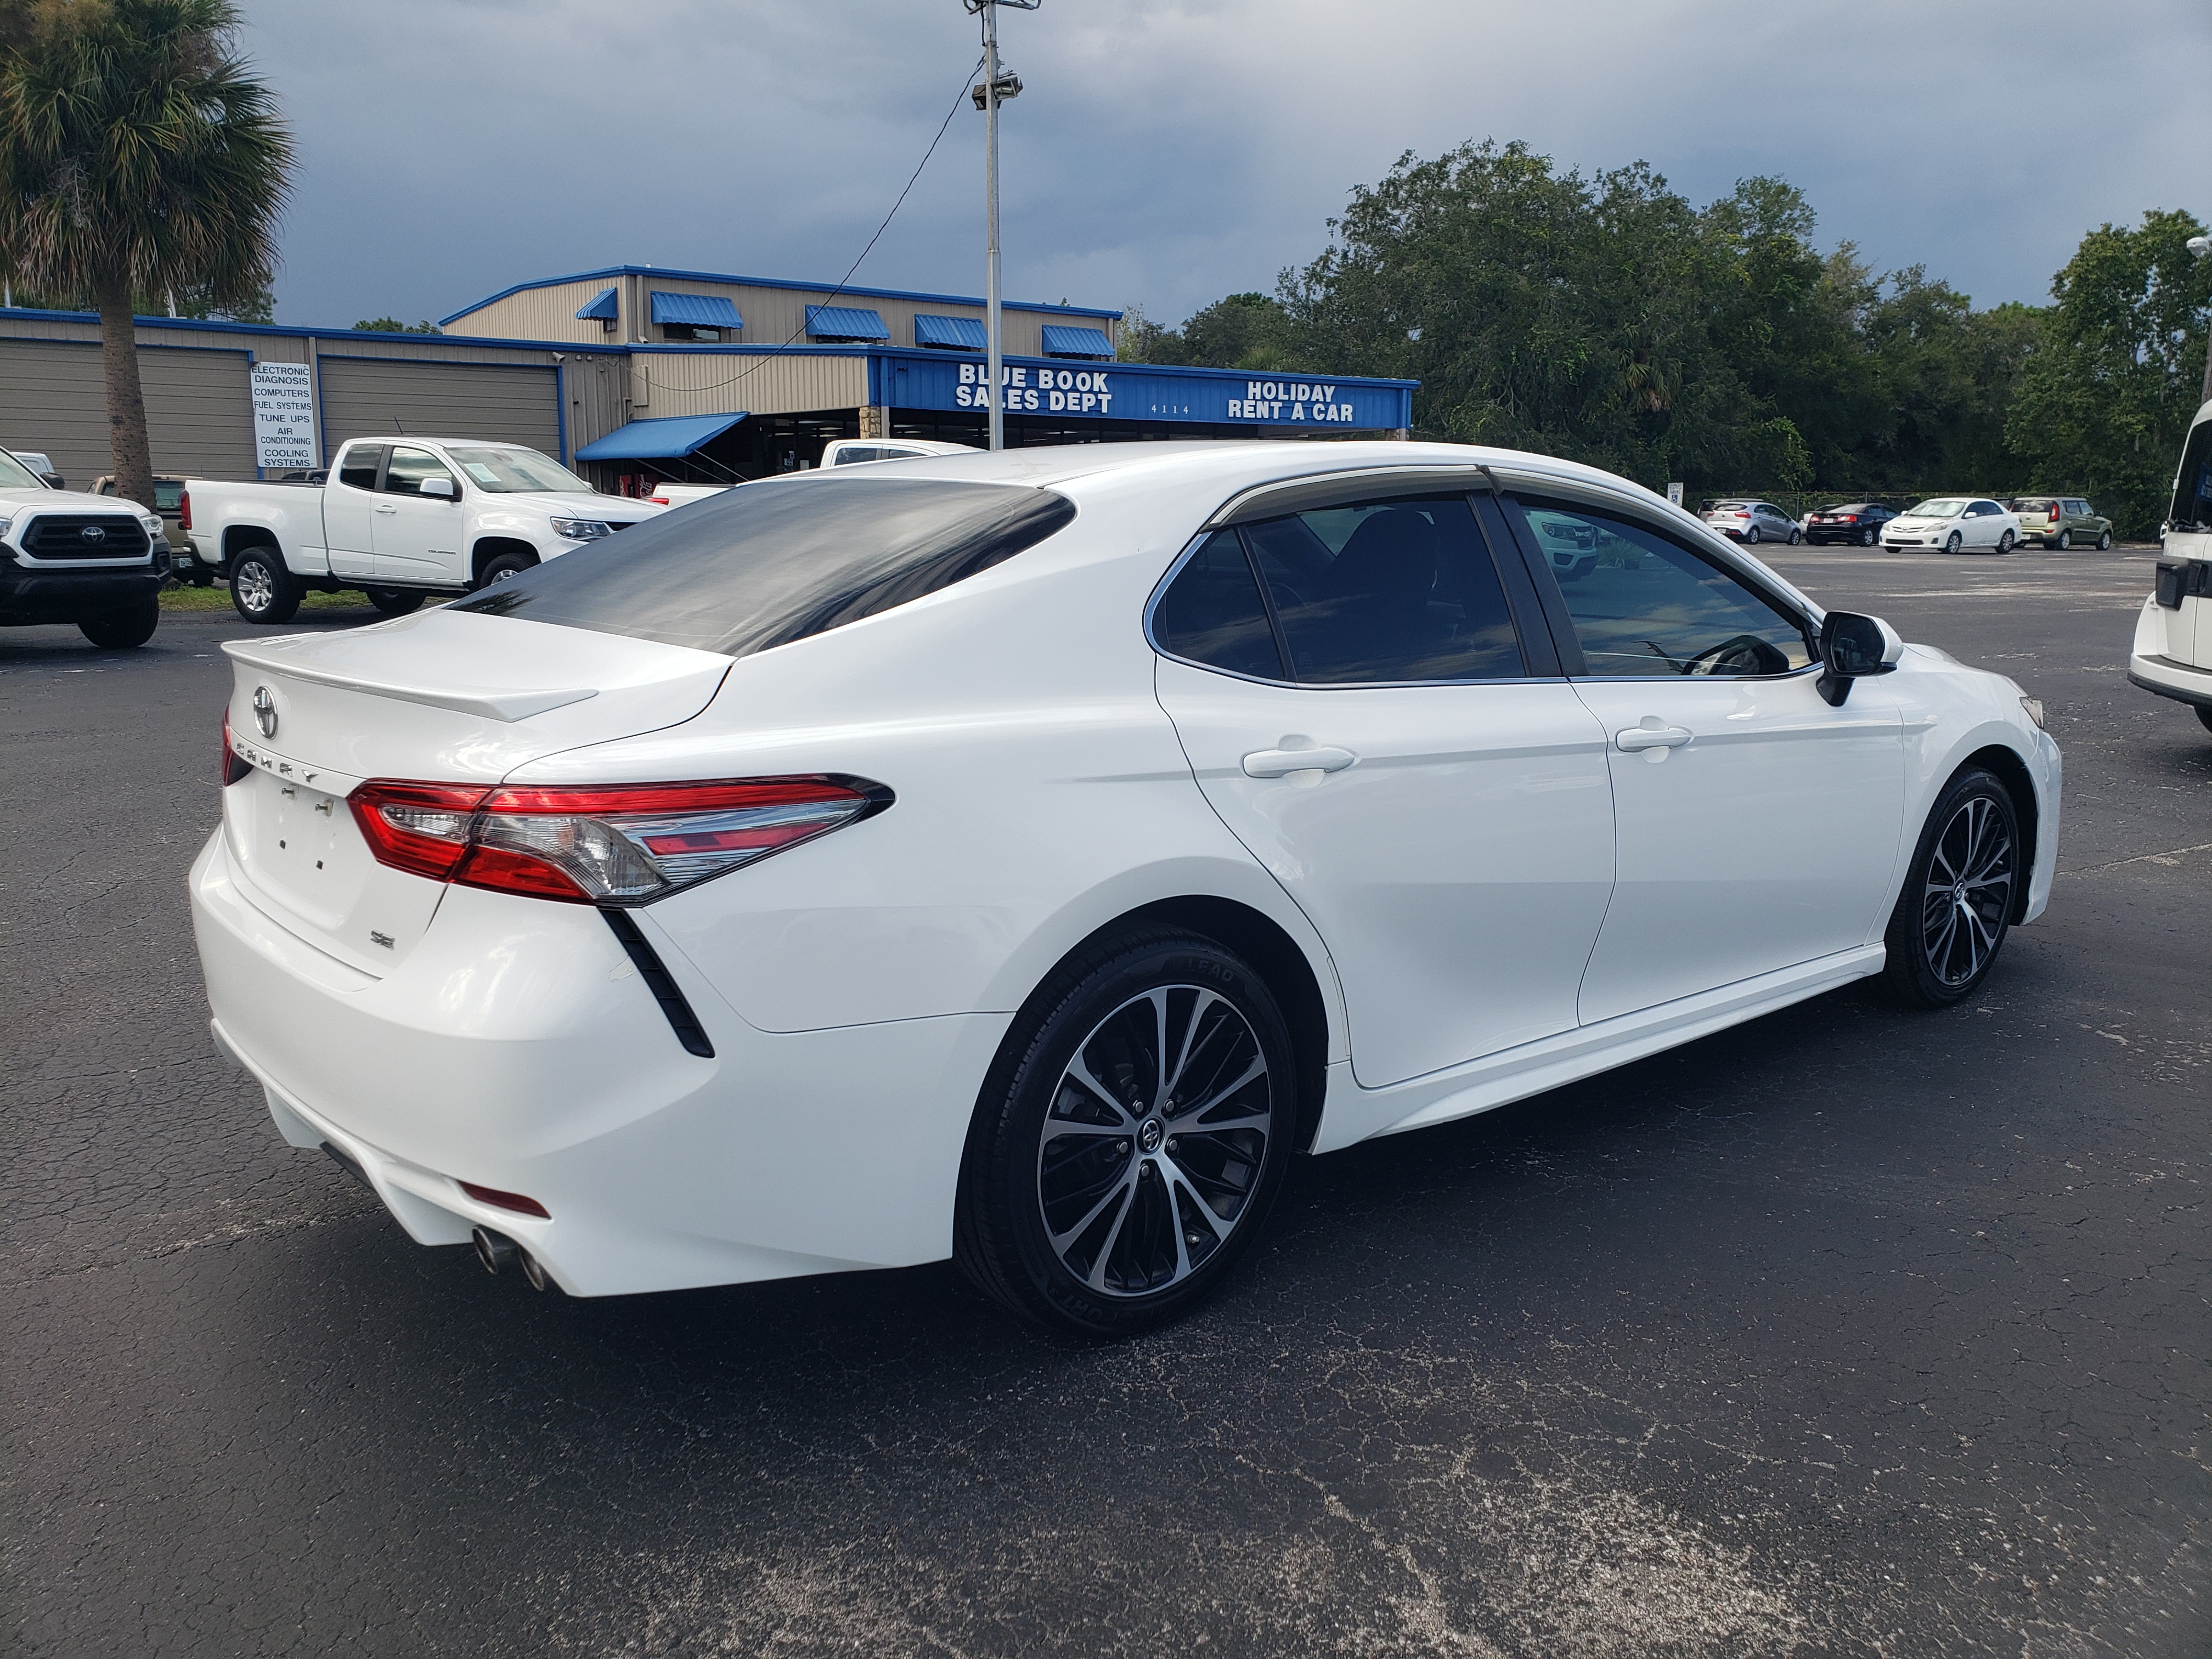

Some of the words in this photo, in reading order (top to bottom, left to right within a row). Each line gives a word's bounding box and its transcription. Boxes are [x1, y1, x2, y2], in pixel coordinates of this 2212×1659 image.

[252, 365, 309, 376] ELECTRONIC
[255, 375, 308, 385] DIAGNOSIS
[1039, 369, 1109, 392] BOOK
[254, 388, 309, 398] COMPUTERS
[1248, 381, 1336, 402] HOLIDAY
[956, 385, 1039, 410] SAES
[1049, 391, 1111, 413] DEPT
[254, 400, 273, 409] FUEL
[276, 402, 312, 410] SYSTEMS
[1151, 404, 1188, 414] 4114
[1228, 399, 1283, 419] RENT
[1291, 402, 1305, 420] A
[1312, 403, 1353, 421] CAR
[259, 414, 286, 422] TUNE
[261, 436, 311, 445] CONDITIONING
[264, 449, 308, 458] COOLING
[236, 742, 319, 783] CAMRY
[370, 929, 395, 950] SE
